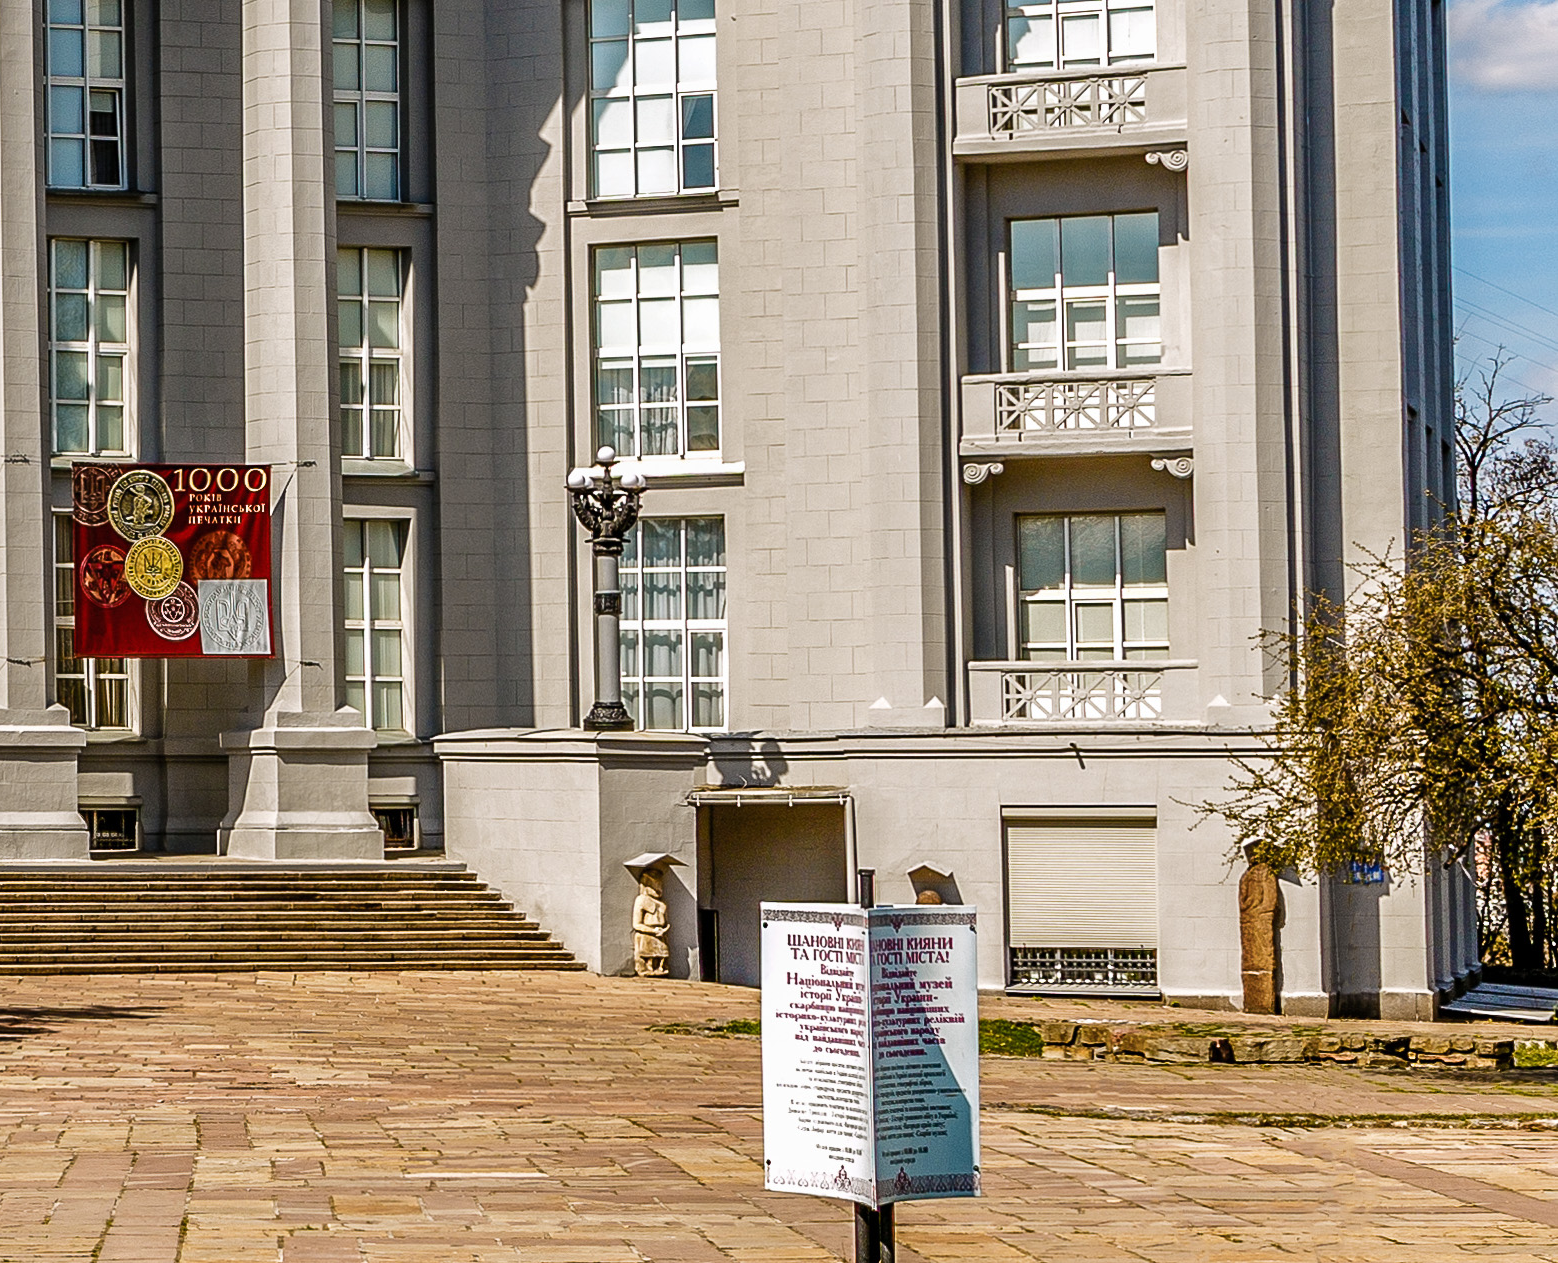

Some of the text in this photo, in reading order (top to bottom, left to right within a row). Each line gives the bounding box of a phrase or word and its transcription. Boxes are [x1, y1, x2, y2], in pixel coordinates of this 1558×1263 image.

[173, 467, 268, 492] 1000
[189, 493, 222, 502] РОКІВ
[189, 502, 266, 514] УКРАЇНСЬКОЇ
[188, 515, 242, 525] ПЕЧАТКИ
[787, 934, 844, 950] ШАНОВНІ
[906, 937, 954, 951] КИЯНИ
[790, 947, 810, 961] ТА
[813, 949, 844, 963] ГОСТІ
[877, 952, 903, 966] ГОСТІ
[905, 951, 950, 964] МІСТА!
[918, 976, 953, 993] музей
[800, 987, 833, 1003] історії
[923, 1013, 965, 1027] реліквій
